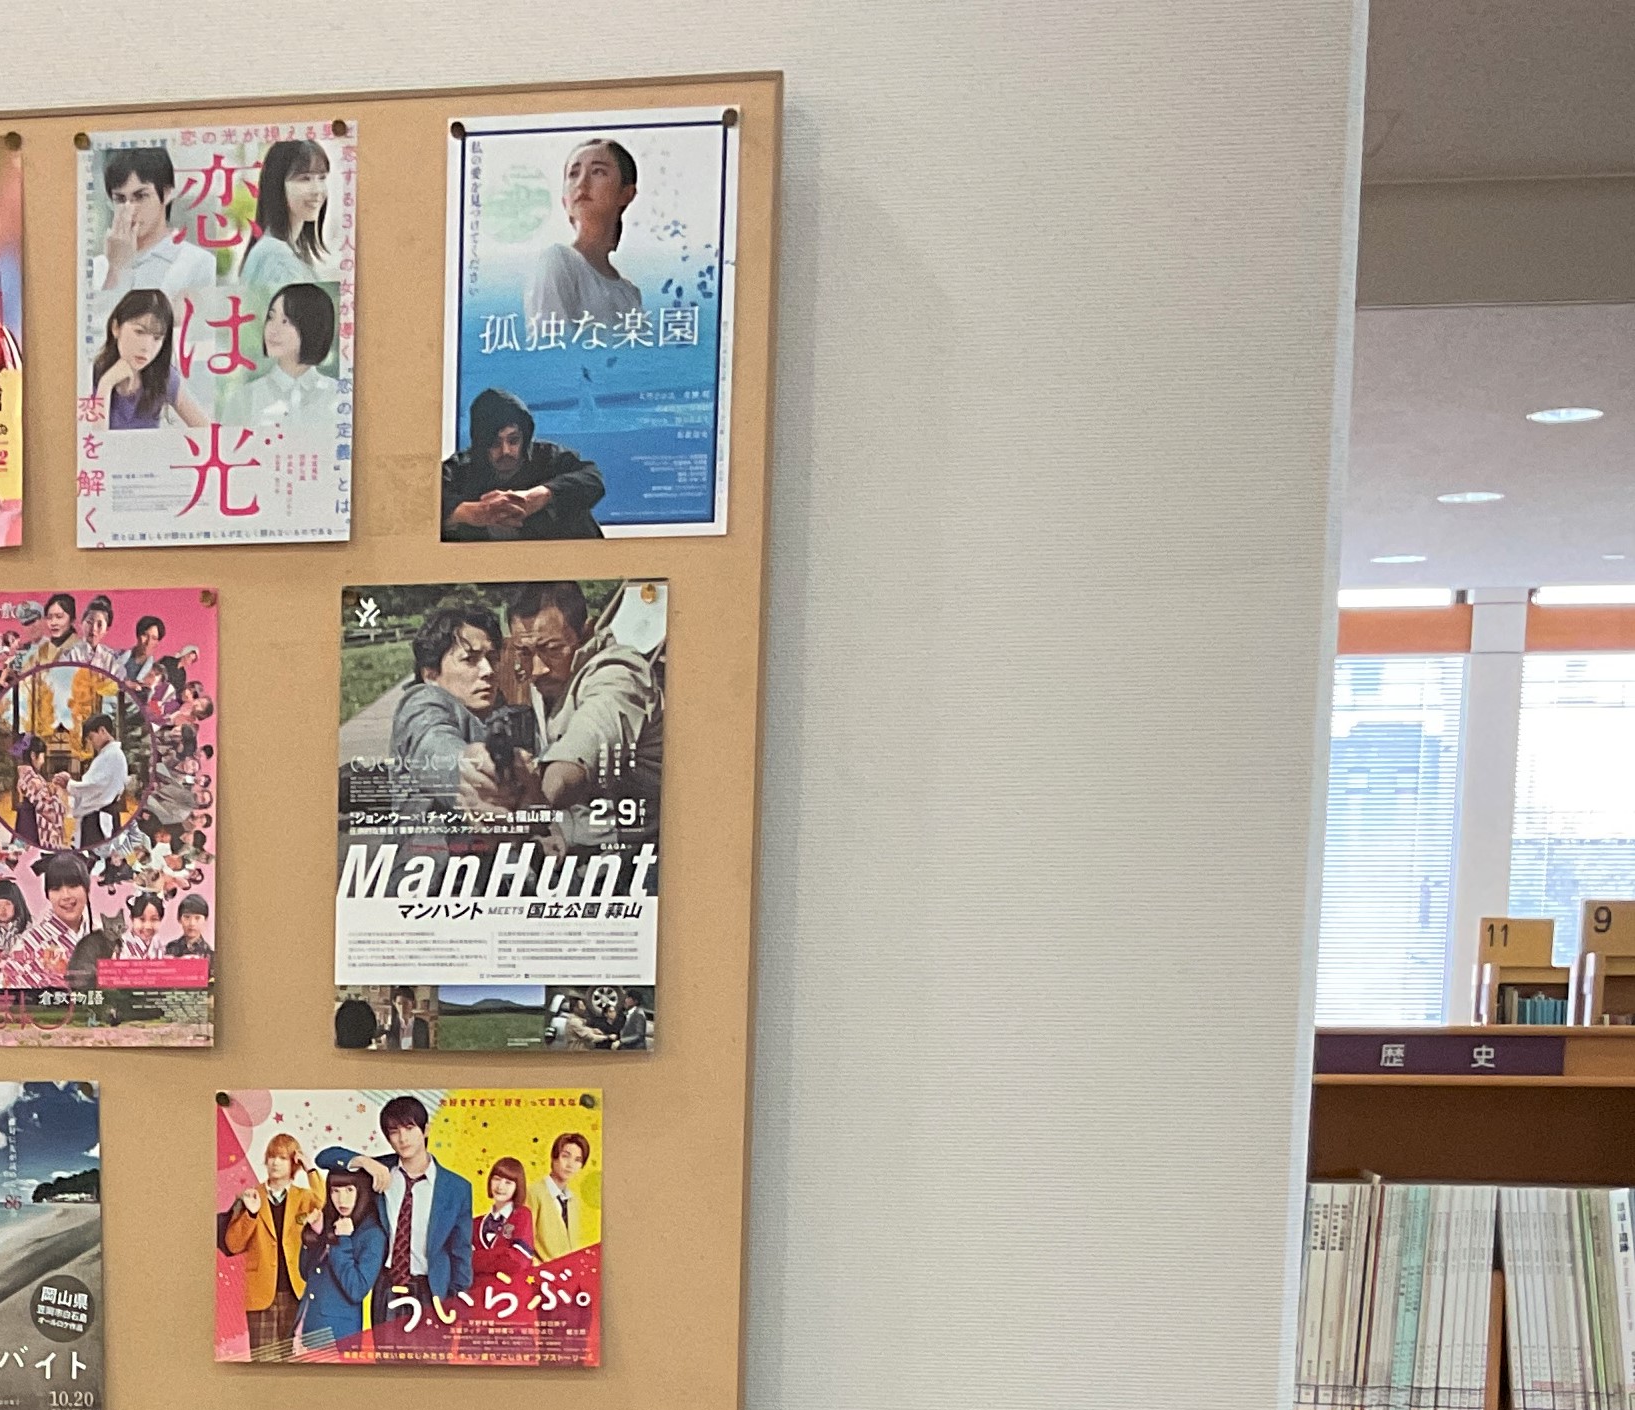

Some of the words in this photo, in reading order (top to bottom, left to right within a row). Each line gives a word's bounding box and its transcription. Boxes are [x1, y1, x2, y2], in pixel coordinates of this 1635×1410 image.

[478, 304, 701, 355] 孤独な楽園
[588, 798, 637, 827] 2.9
[338, 842, 658, 898] ManHunt
[397, 903, 484, 920] マンハント
[526, 902, 602, 919] 国立公園
[1592, 905, 1613, 933] 9
[1486, 923, 1510, 948] 11
[40, 1285, 89, 1311] 岡山県
[387, 1268, 592, 1333] ういらぶ。
[49, 1390, 95, 1408] 10.20
